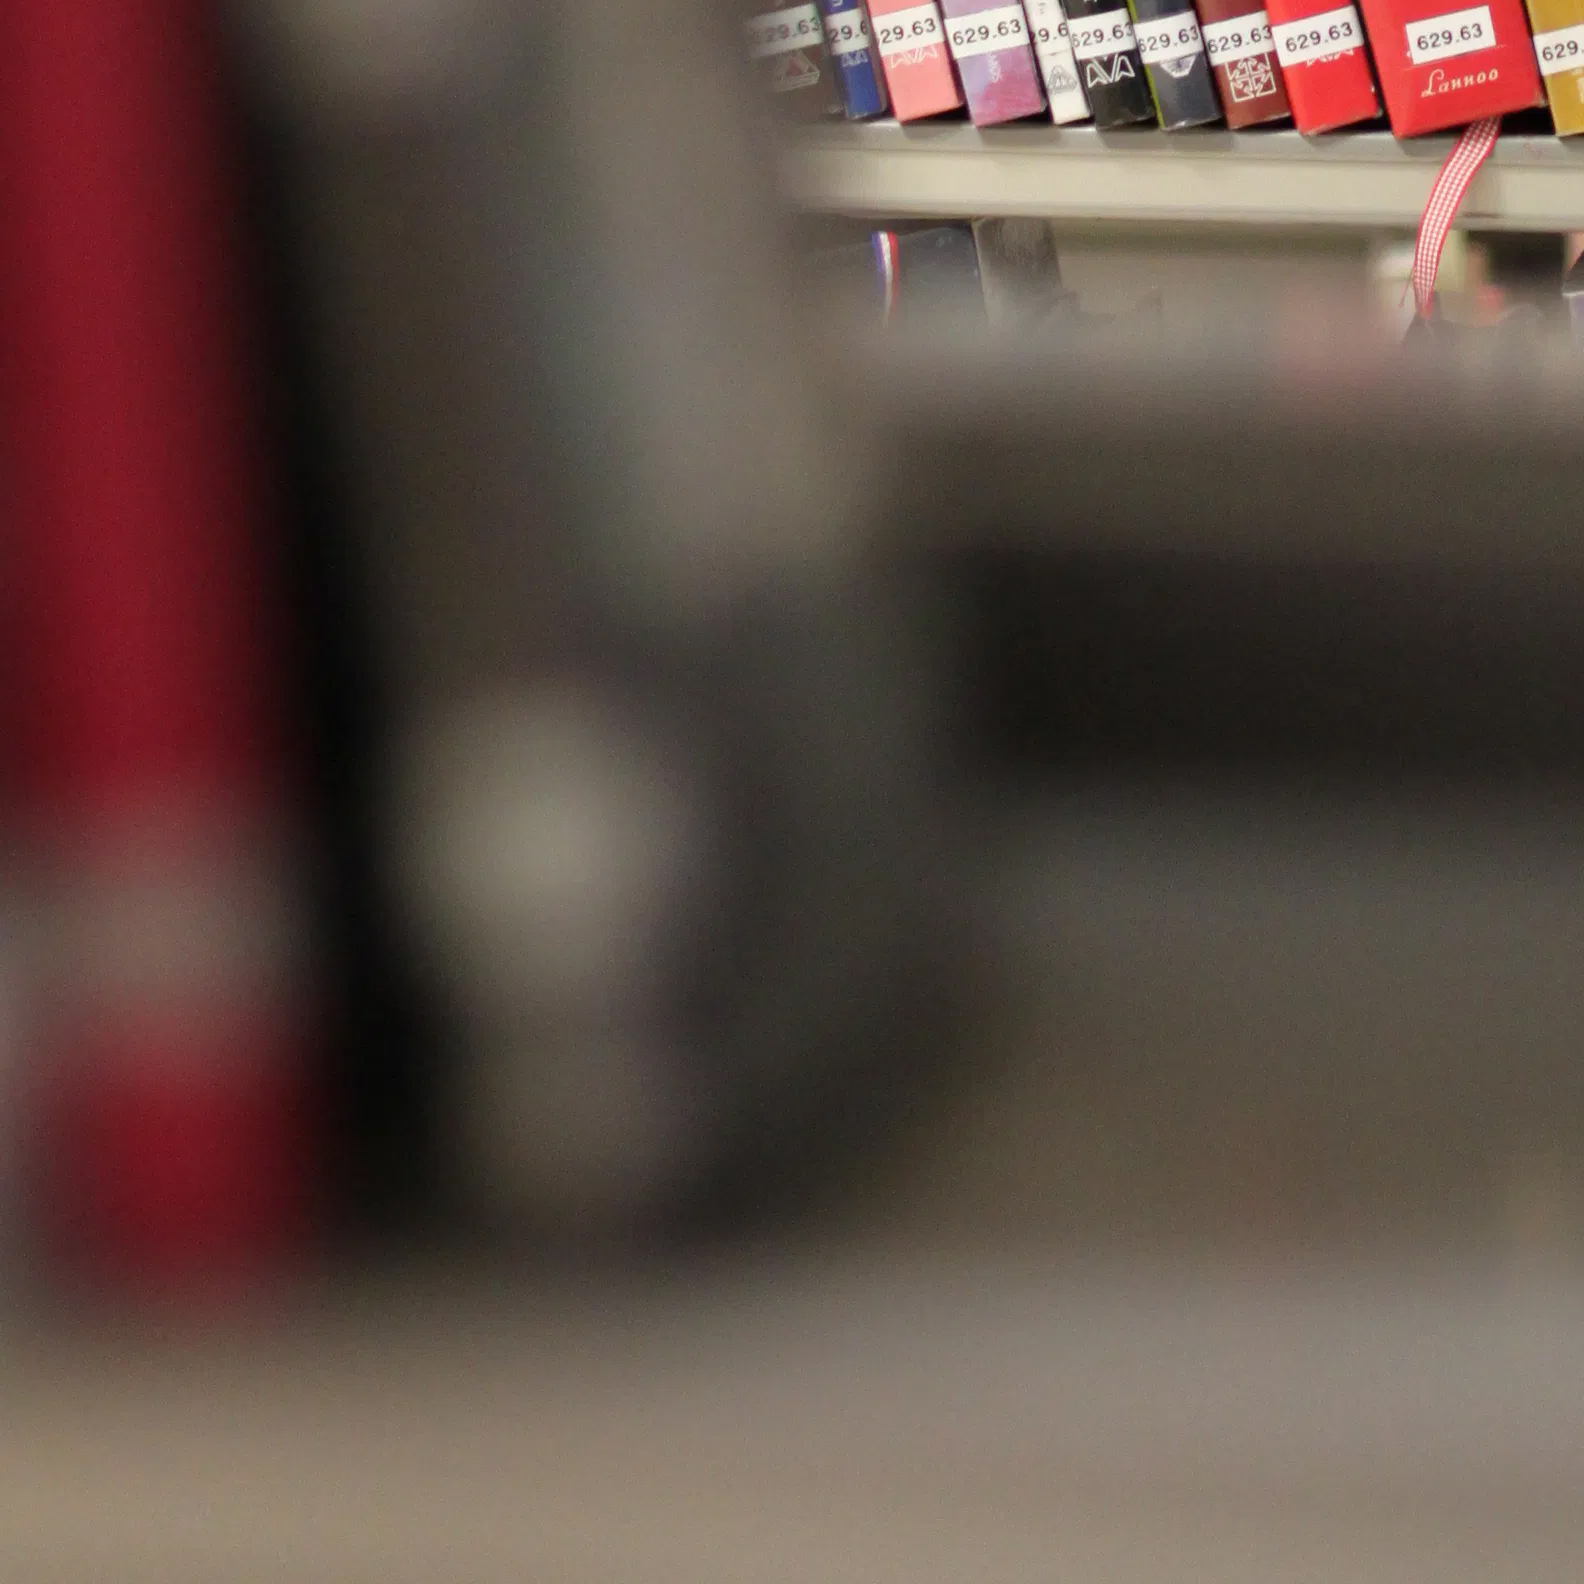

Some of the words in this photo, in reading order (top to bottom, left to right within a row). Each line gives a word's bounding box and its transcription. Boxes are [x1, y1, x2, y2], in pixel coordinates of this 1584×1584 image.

[953, 19, 1022, 46] 629.63
[1285, 22, 1354, 54] 629.63
[1416, 22, 1485, 52] 629.63
[1420, 63, 1500, 101] Lannoo
